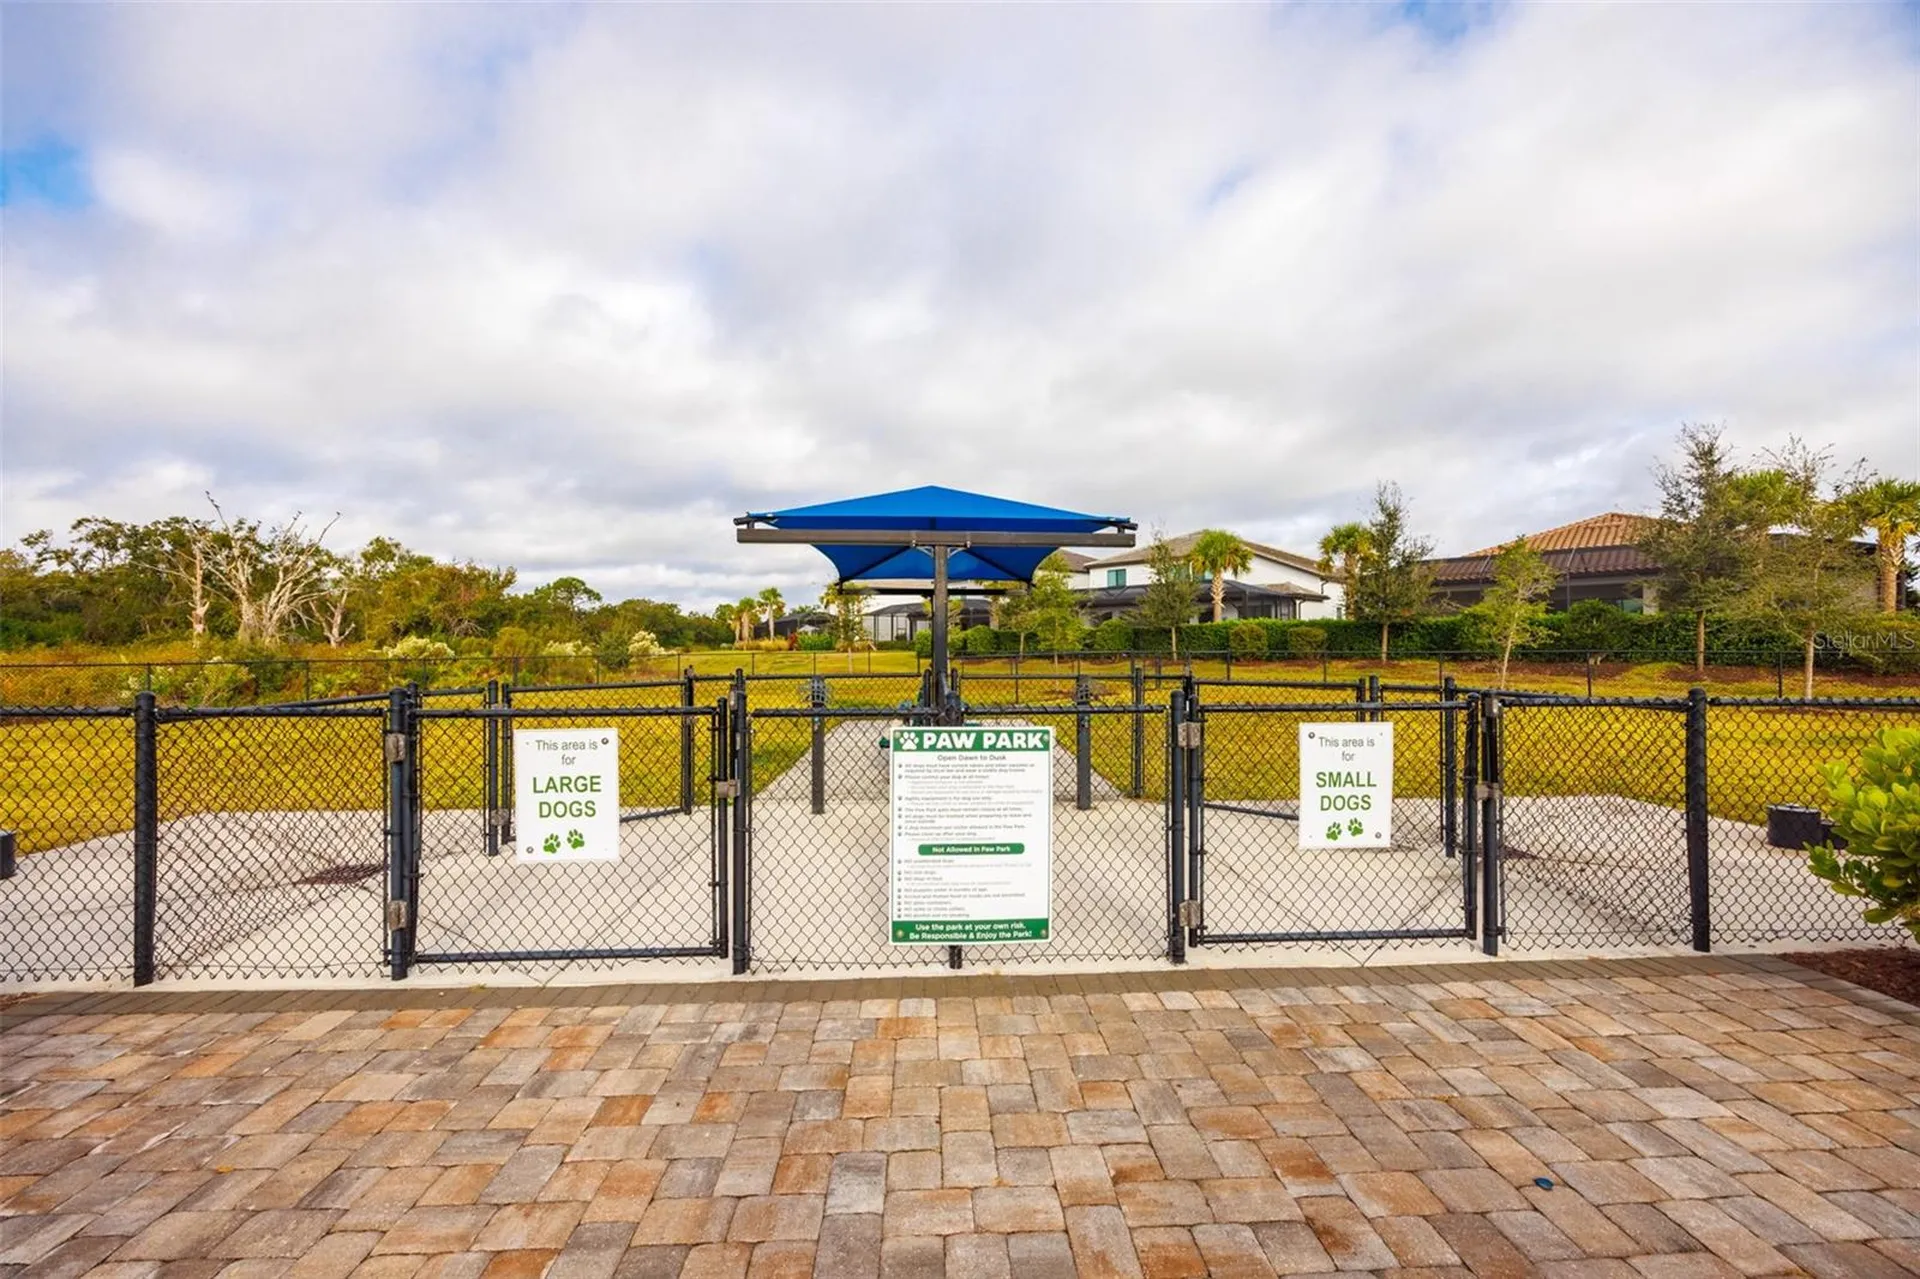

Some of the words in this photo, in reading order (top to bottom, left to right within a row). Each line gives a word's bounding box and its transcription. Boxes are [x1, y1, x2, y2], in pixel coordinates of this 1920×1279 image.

[535, 739, 559, 750] This
[561, 741, 586, 750] area
[588, 739, 598, 750] is
[922, 732, 977, 749] PAW
[983, 731, 1044, 749] PARK
[1318, 737, 1339, 747] This
[1341, 738, 1364, 747] area
[1366, 737, 1375, 747] is
[561, 754, 576, 765] for
[937, 754, 957, 762] Open
[1341, 751, 1355, 762] for
[532, 775, 602, 794] LARGE
[1315, 771, 1377, 788] SMALL
[1319, 794, 1372, 811] DOGS
[538, 800, 597, 818] DOGS
[945, 924, 963, 932] park
[921, 932, 967, 940] Responsible
[976, 932, 998, 940] Enjoy
[1012, 930, 1033, 938] Park!
